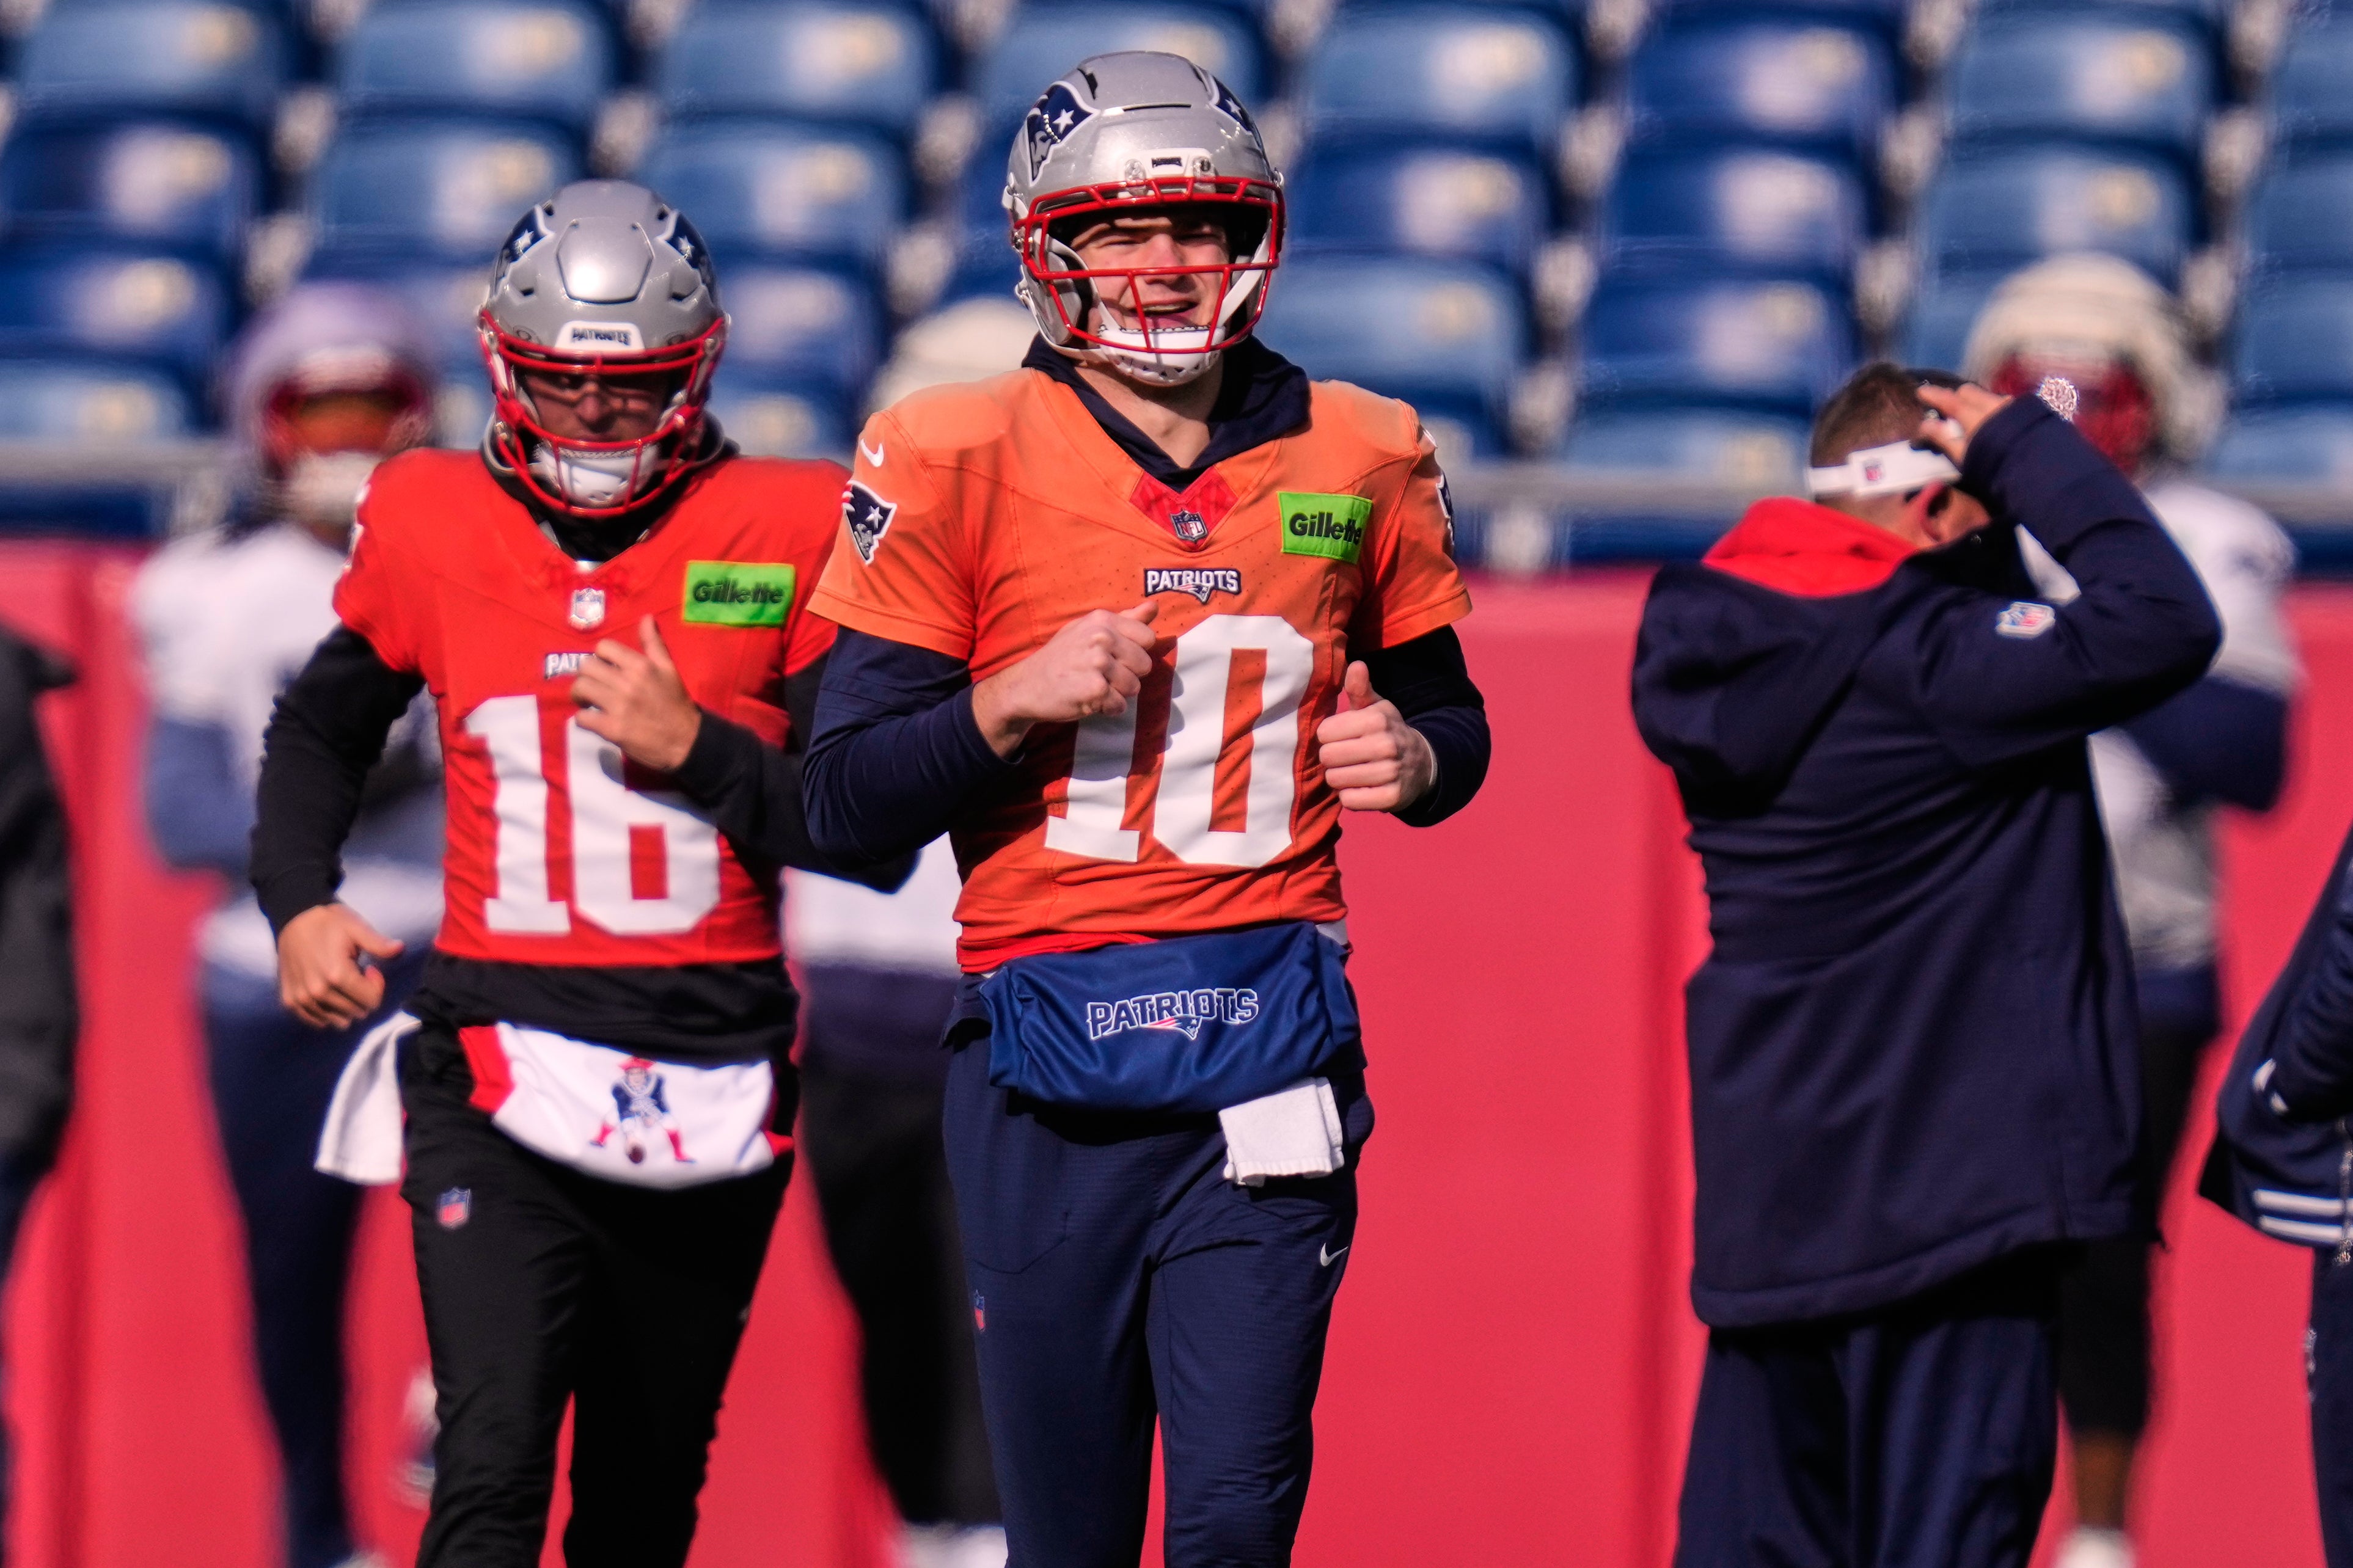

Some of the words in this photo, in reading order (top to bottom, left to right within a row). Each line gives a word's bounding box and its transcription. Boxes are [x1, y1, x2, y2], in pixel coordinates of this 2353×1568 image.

[693, 577, 785, 603] Gillette
[1146, 569, 1240, 594] PATRIOTS
[1044, 613, 1314, 868] 10
[464, 694, 722, 936] 16
[1086, 988, 1259, 1040] PATRIOTS
